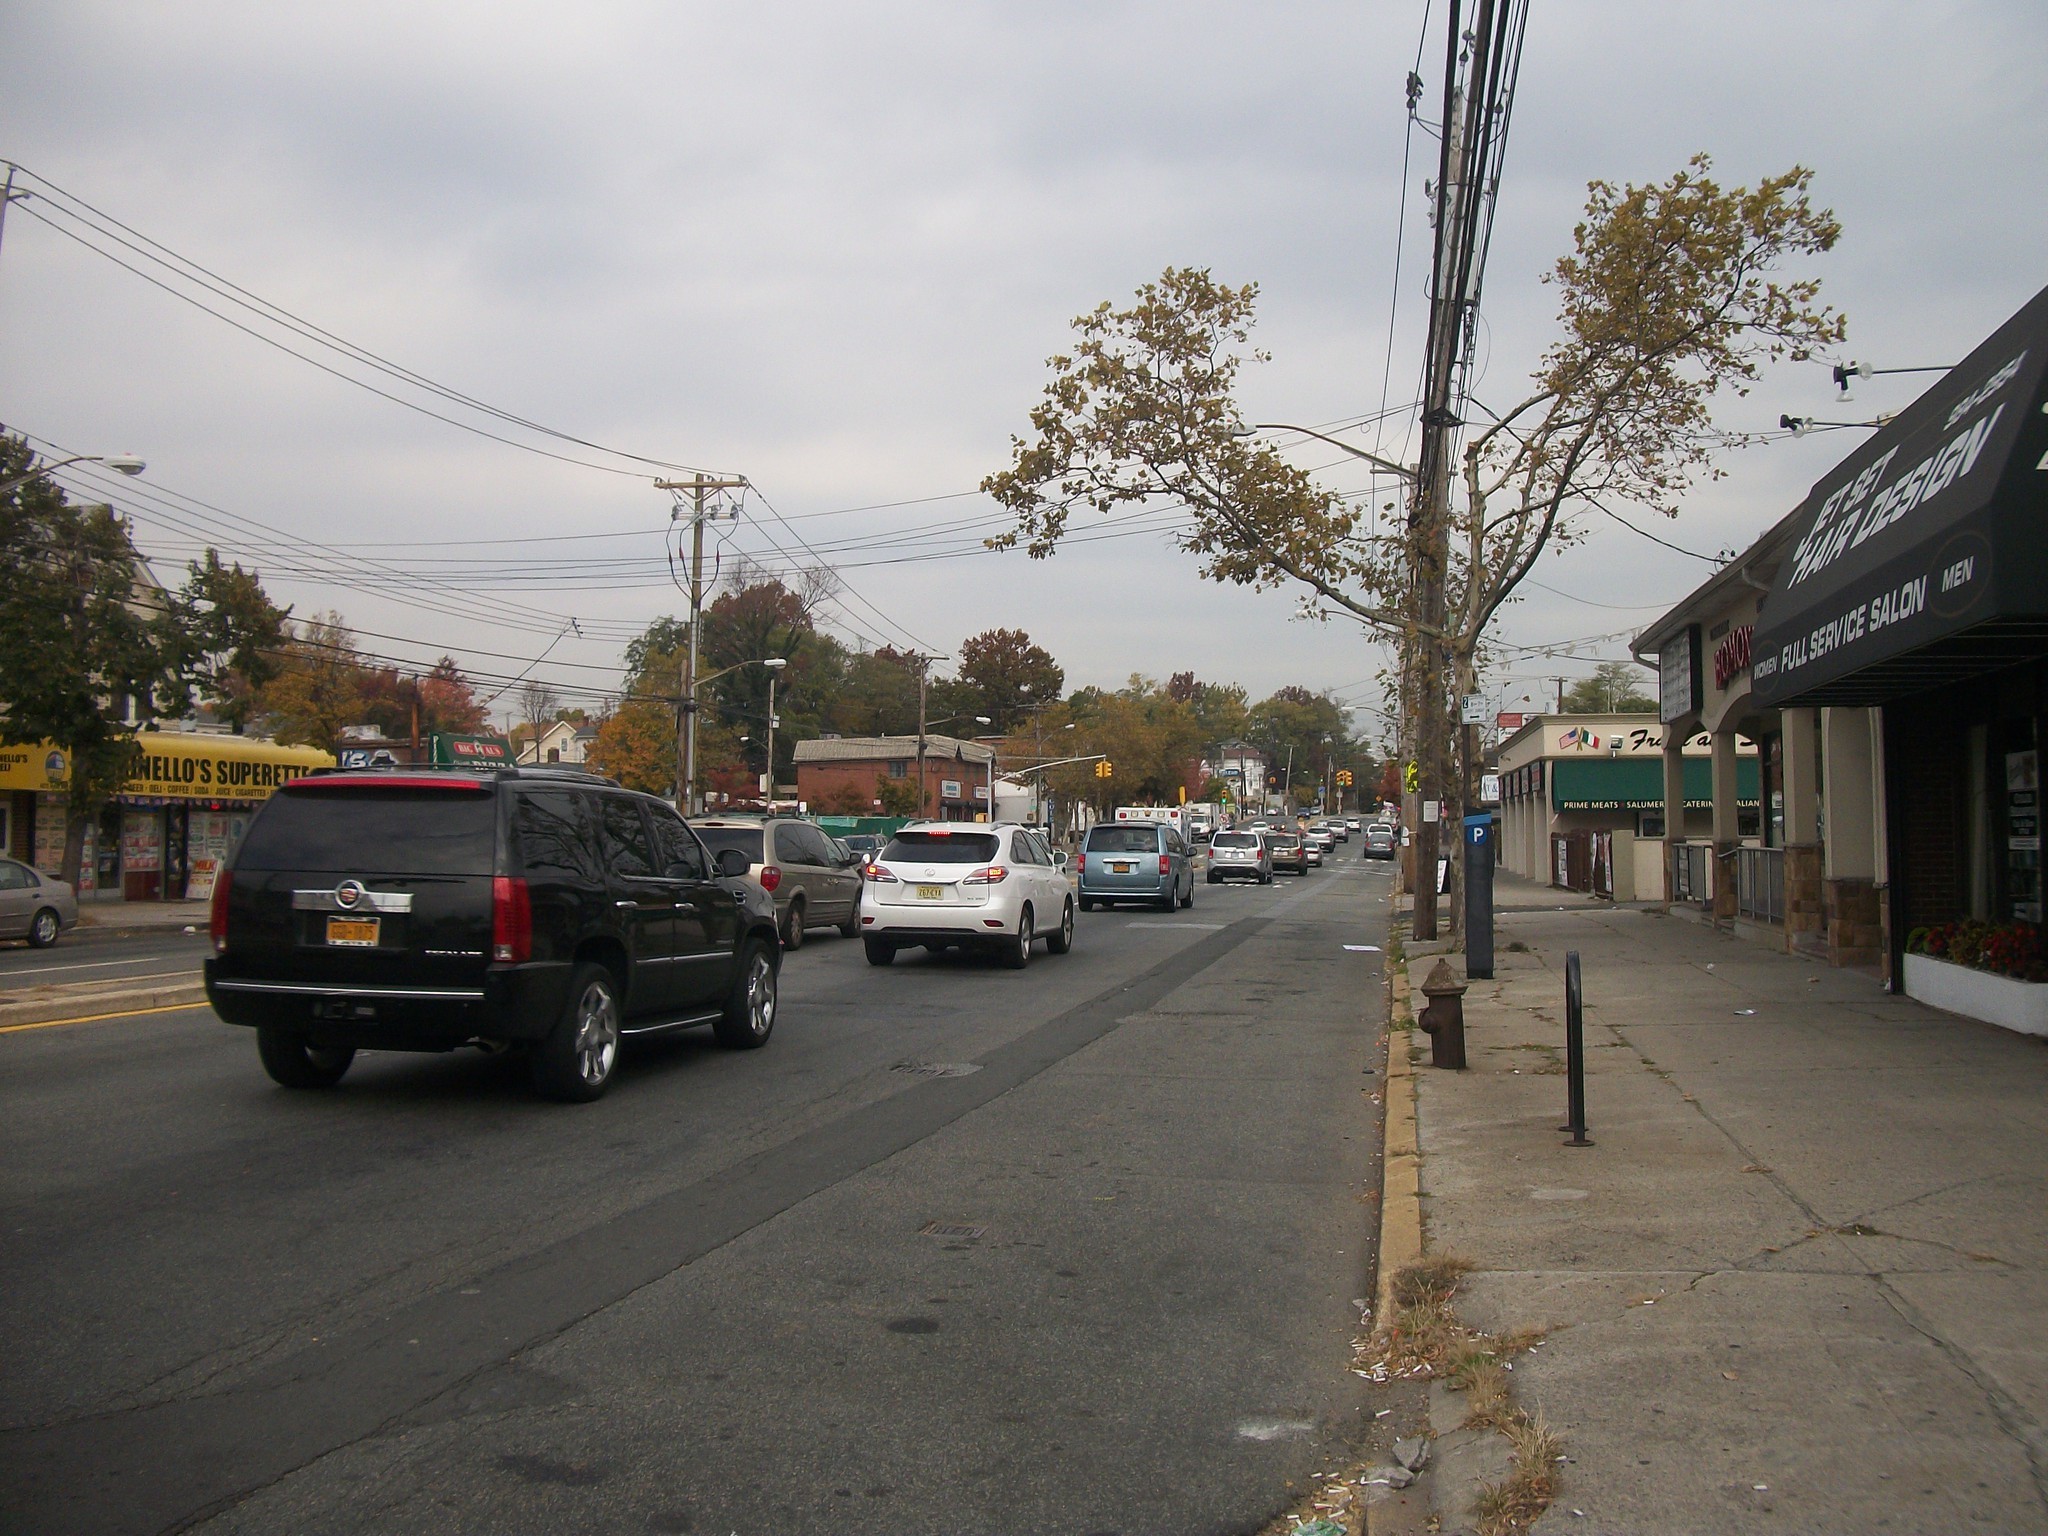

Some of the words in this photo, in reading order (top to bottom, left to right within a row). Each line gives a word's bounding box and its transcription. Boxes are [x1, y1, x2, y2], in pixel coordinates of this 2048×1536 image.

[1787, 508, 1863, 590] HAIR
[1850, 402, 2007, 549] DESIGN
[1793, 480, 1853, 562] JET
[1842, 444, 1900, 513] SET
[1941, 556, 1974, 593] MEN
[1781, 635, 1808, 673] FULL
[1809, 604, 1867, 661] SERVICE
[1869, 575, 1928, 633] SALON
[1754, 655, 1779, 680] WOMEN
[458, 744, 473, 754] BIG
[167, 785, 190, 794] COFFEE
[216, 787, 231, 796] JUICE
[1563, 801, 1589, 809] PRIME
[1591, 801, 1619, 809] MEATS
[1473, 827, 1484, 843] P
